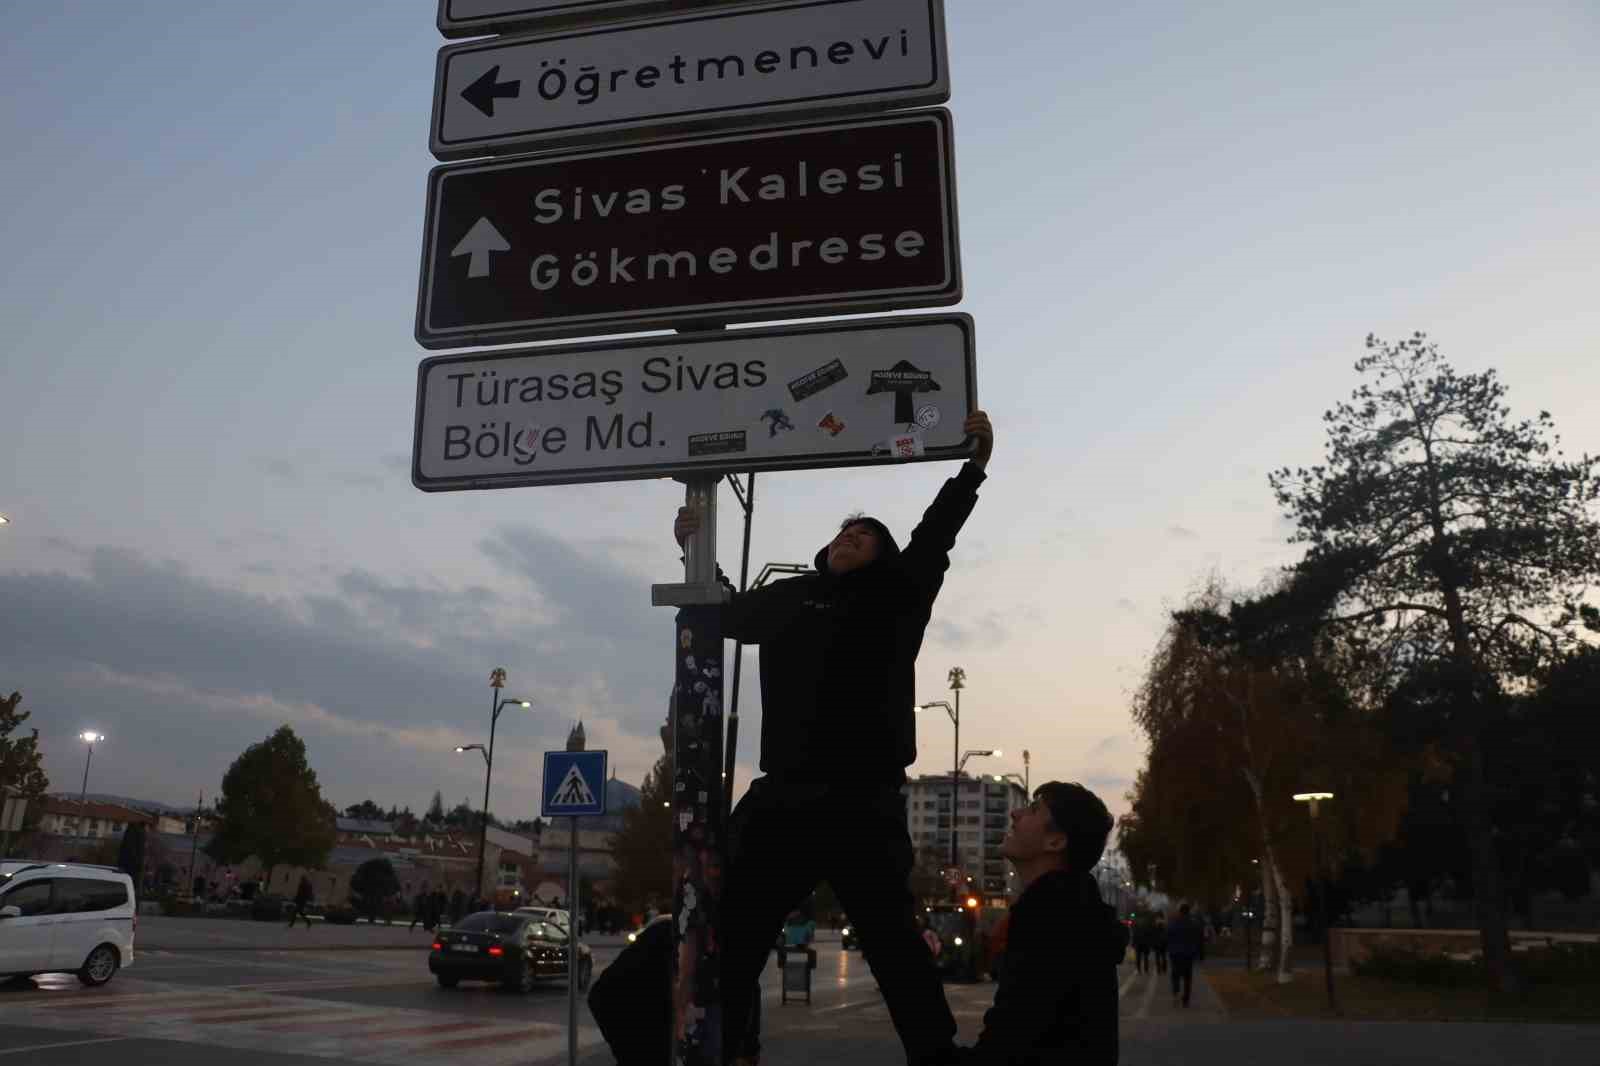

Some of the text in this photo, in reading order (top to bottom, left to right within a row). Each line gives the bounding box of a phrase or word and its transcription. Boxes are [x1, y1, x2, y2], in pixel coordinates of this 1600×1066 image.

[537, 29, 909, 105] Öğretmenevi
[533, 152, 904, 225] Sivas Kalesi
[530, 230, 926, 291] Gökmedrese
[447, 369, 624, 408] Türasaş
[641, 355, 768, 394] Sivas
[585, 411, 667, 453] Md.
